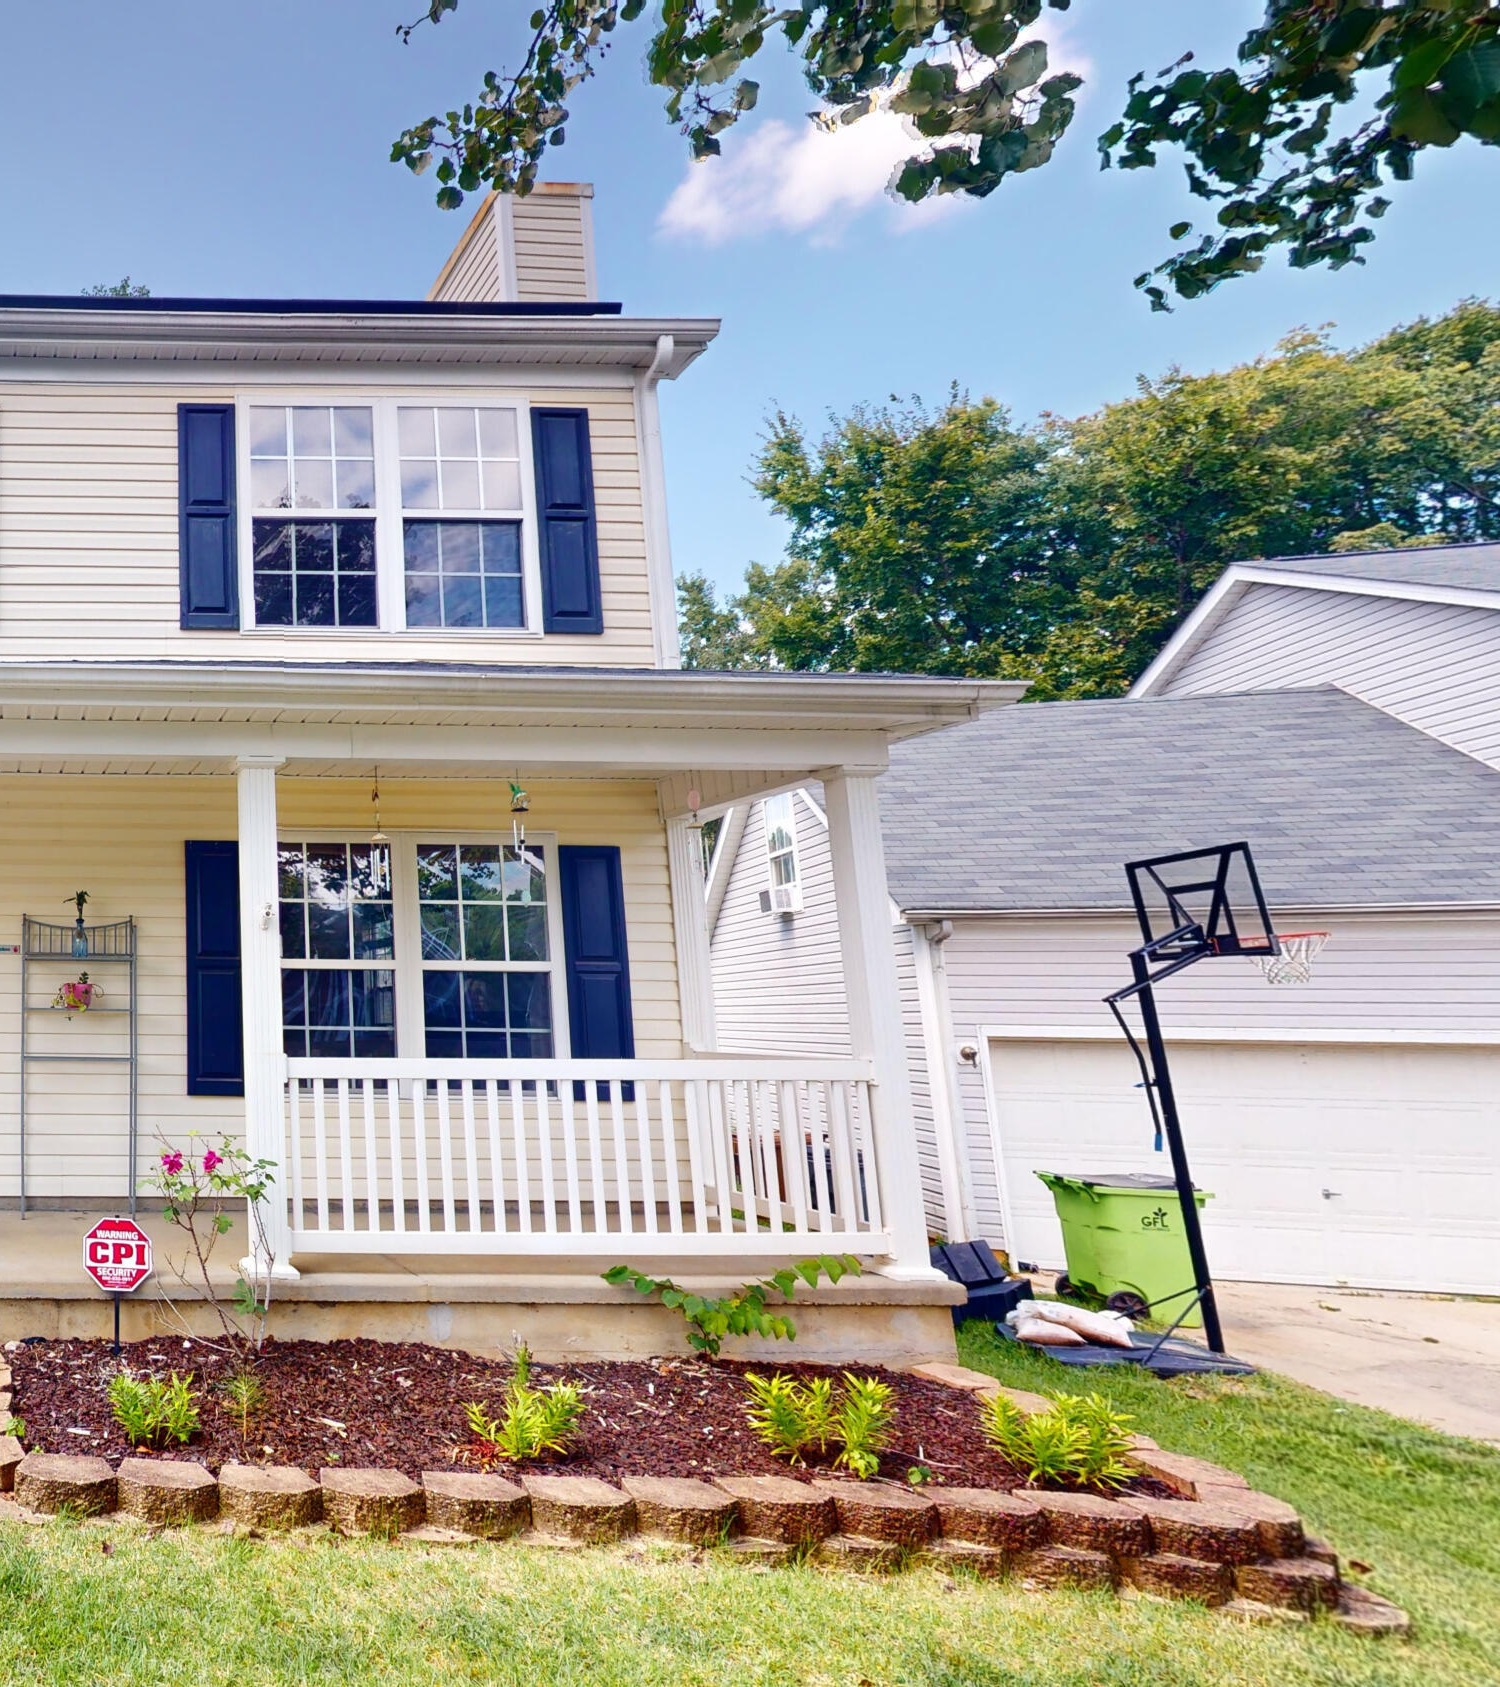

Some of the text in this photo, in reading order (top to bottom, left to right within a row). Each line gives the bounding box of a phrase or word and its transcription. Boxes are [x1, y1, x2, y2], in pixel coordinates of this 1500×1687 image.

[1141, 1215, 1169, 1228] GFL
[96, 1229, 139, 1240] WARNING
[89, 1241, 146, 1266] CPI
[96, 1267, 137, 1277] SECURITY
